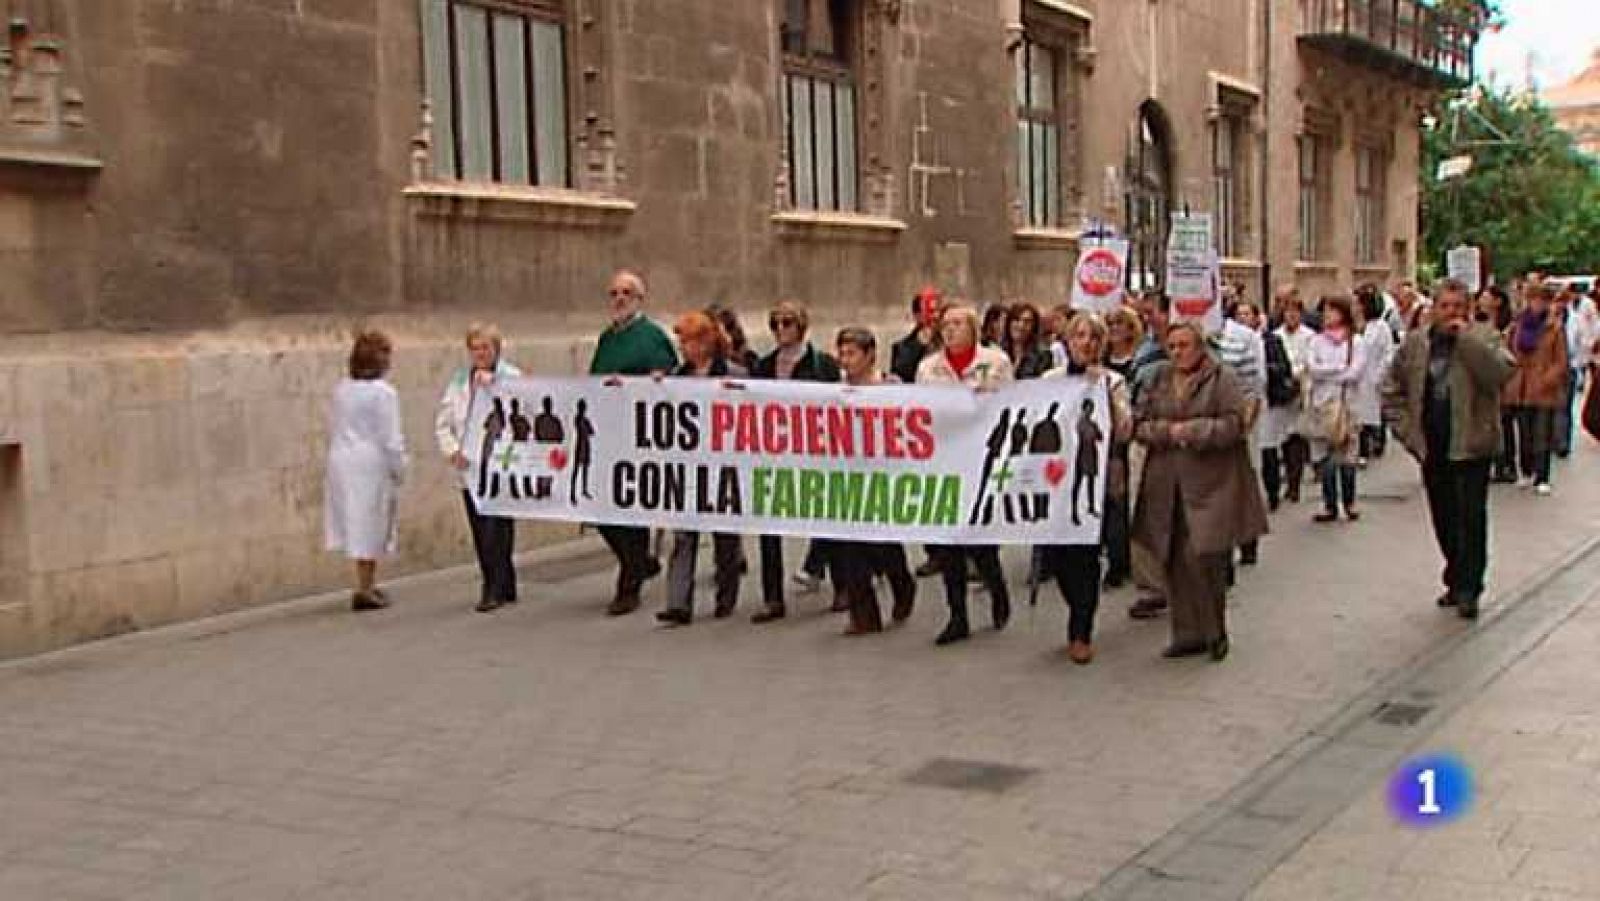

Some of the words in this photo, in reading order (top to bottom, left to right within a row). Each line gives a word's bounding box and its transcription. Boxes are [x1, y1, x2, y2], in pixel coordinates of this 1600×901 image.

[635, 401, 700, 451] LOS
[710, 402, 935, 460] PACIENTES
[612, 460, 686, 511] CON
[696, 464, 742, 517] LA
[752, 466, 961, 526] FARMACIA
